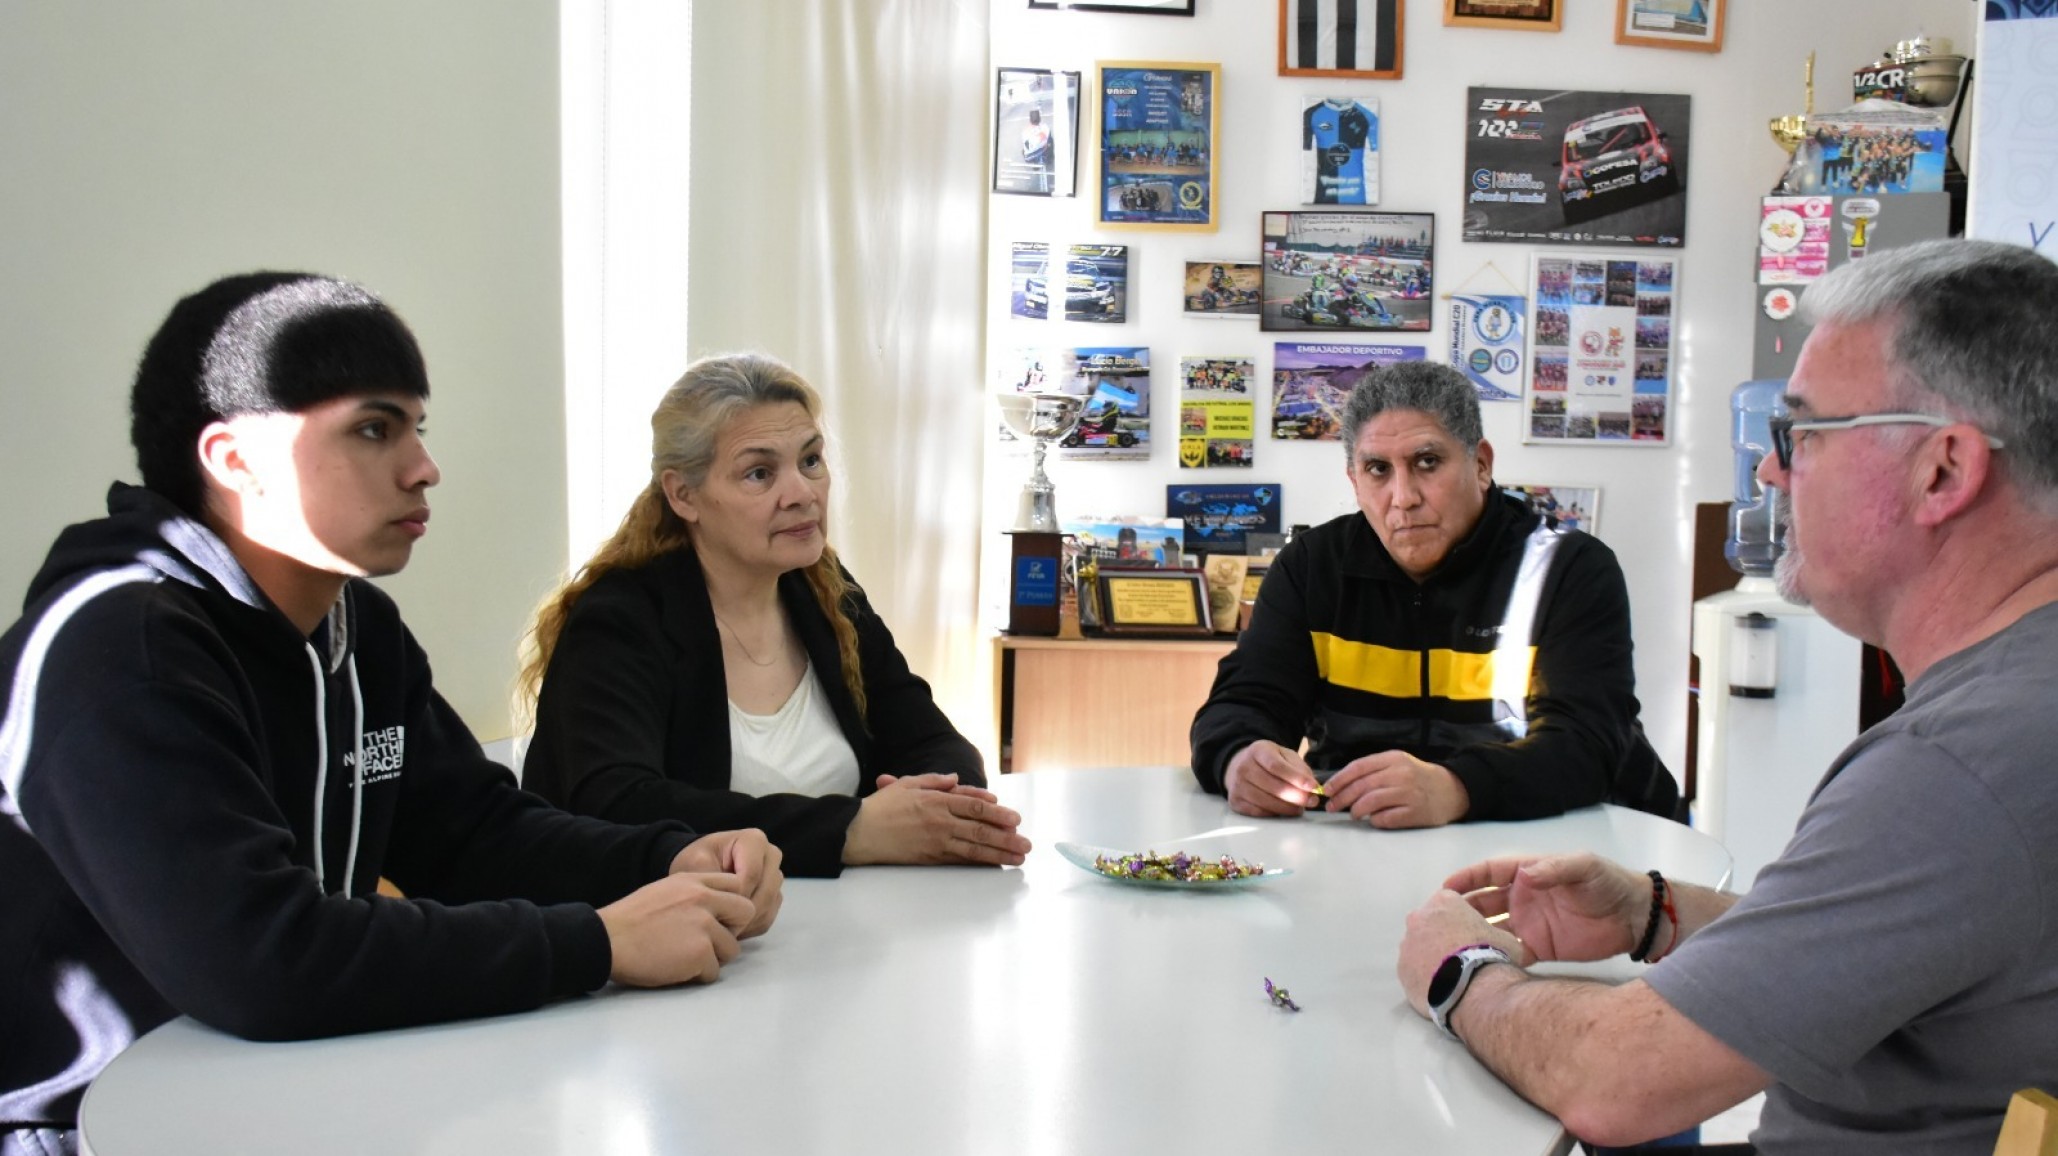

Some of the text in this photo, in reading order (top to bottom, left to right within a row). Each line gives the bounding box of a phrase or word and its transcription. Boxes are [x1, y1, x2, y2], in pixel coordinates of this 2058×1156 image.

[1297, 345, 1404, 355] EMBAJADOR DEPORTIVO
[363, 727, 397, 747] THE
[362, 754, 401, 776] FACE
